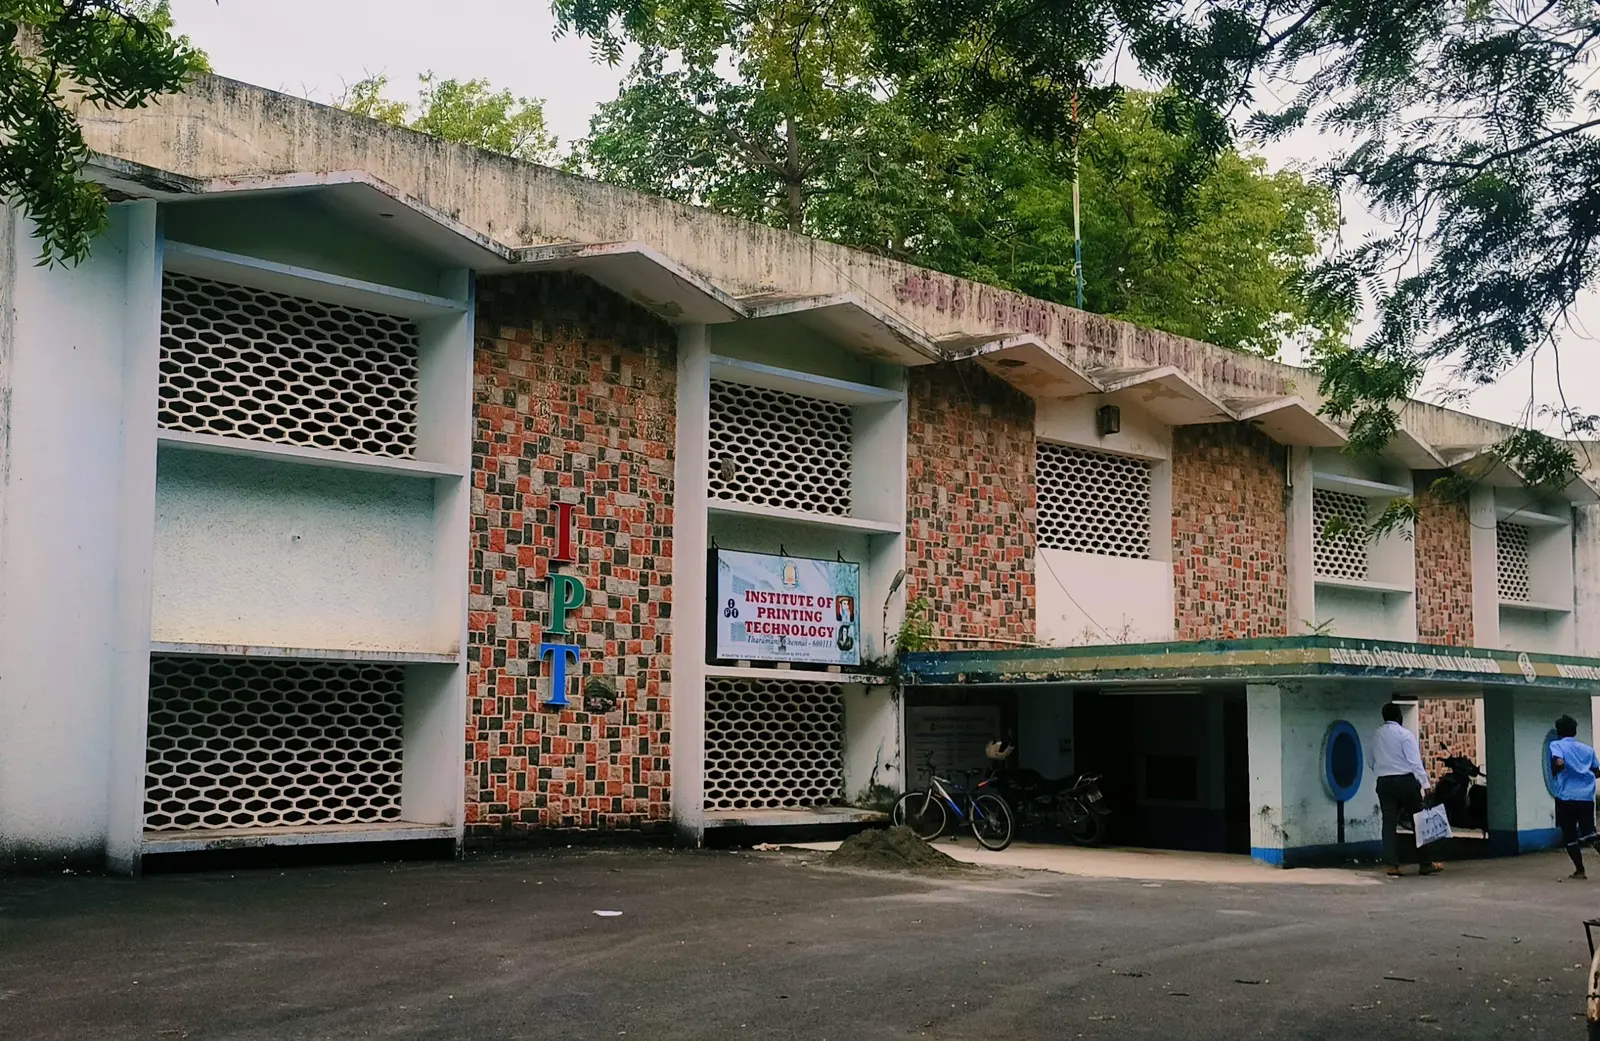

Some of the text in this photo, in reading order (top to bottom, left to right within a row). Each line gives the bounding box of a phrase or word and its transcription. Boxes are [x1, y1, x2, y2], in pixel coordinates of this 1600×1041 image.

[745, 590, 833, 608] INSTITUTE OF
[757, 607, 822, 622] PRINTING
[745, 621, 834, 638] TECHNOLOGY
